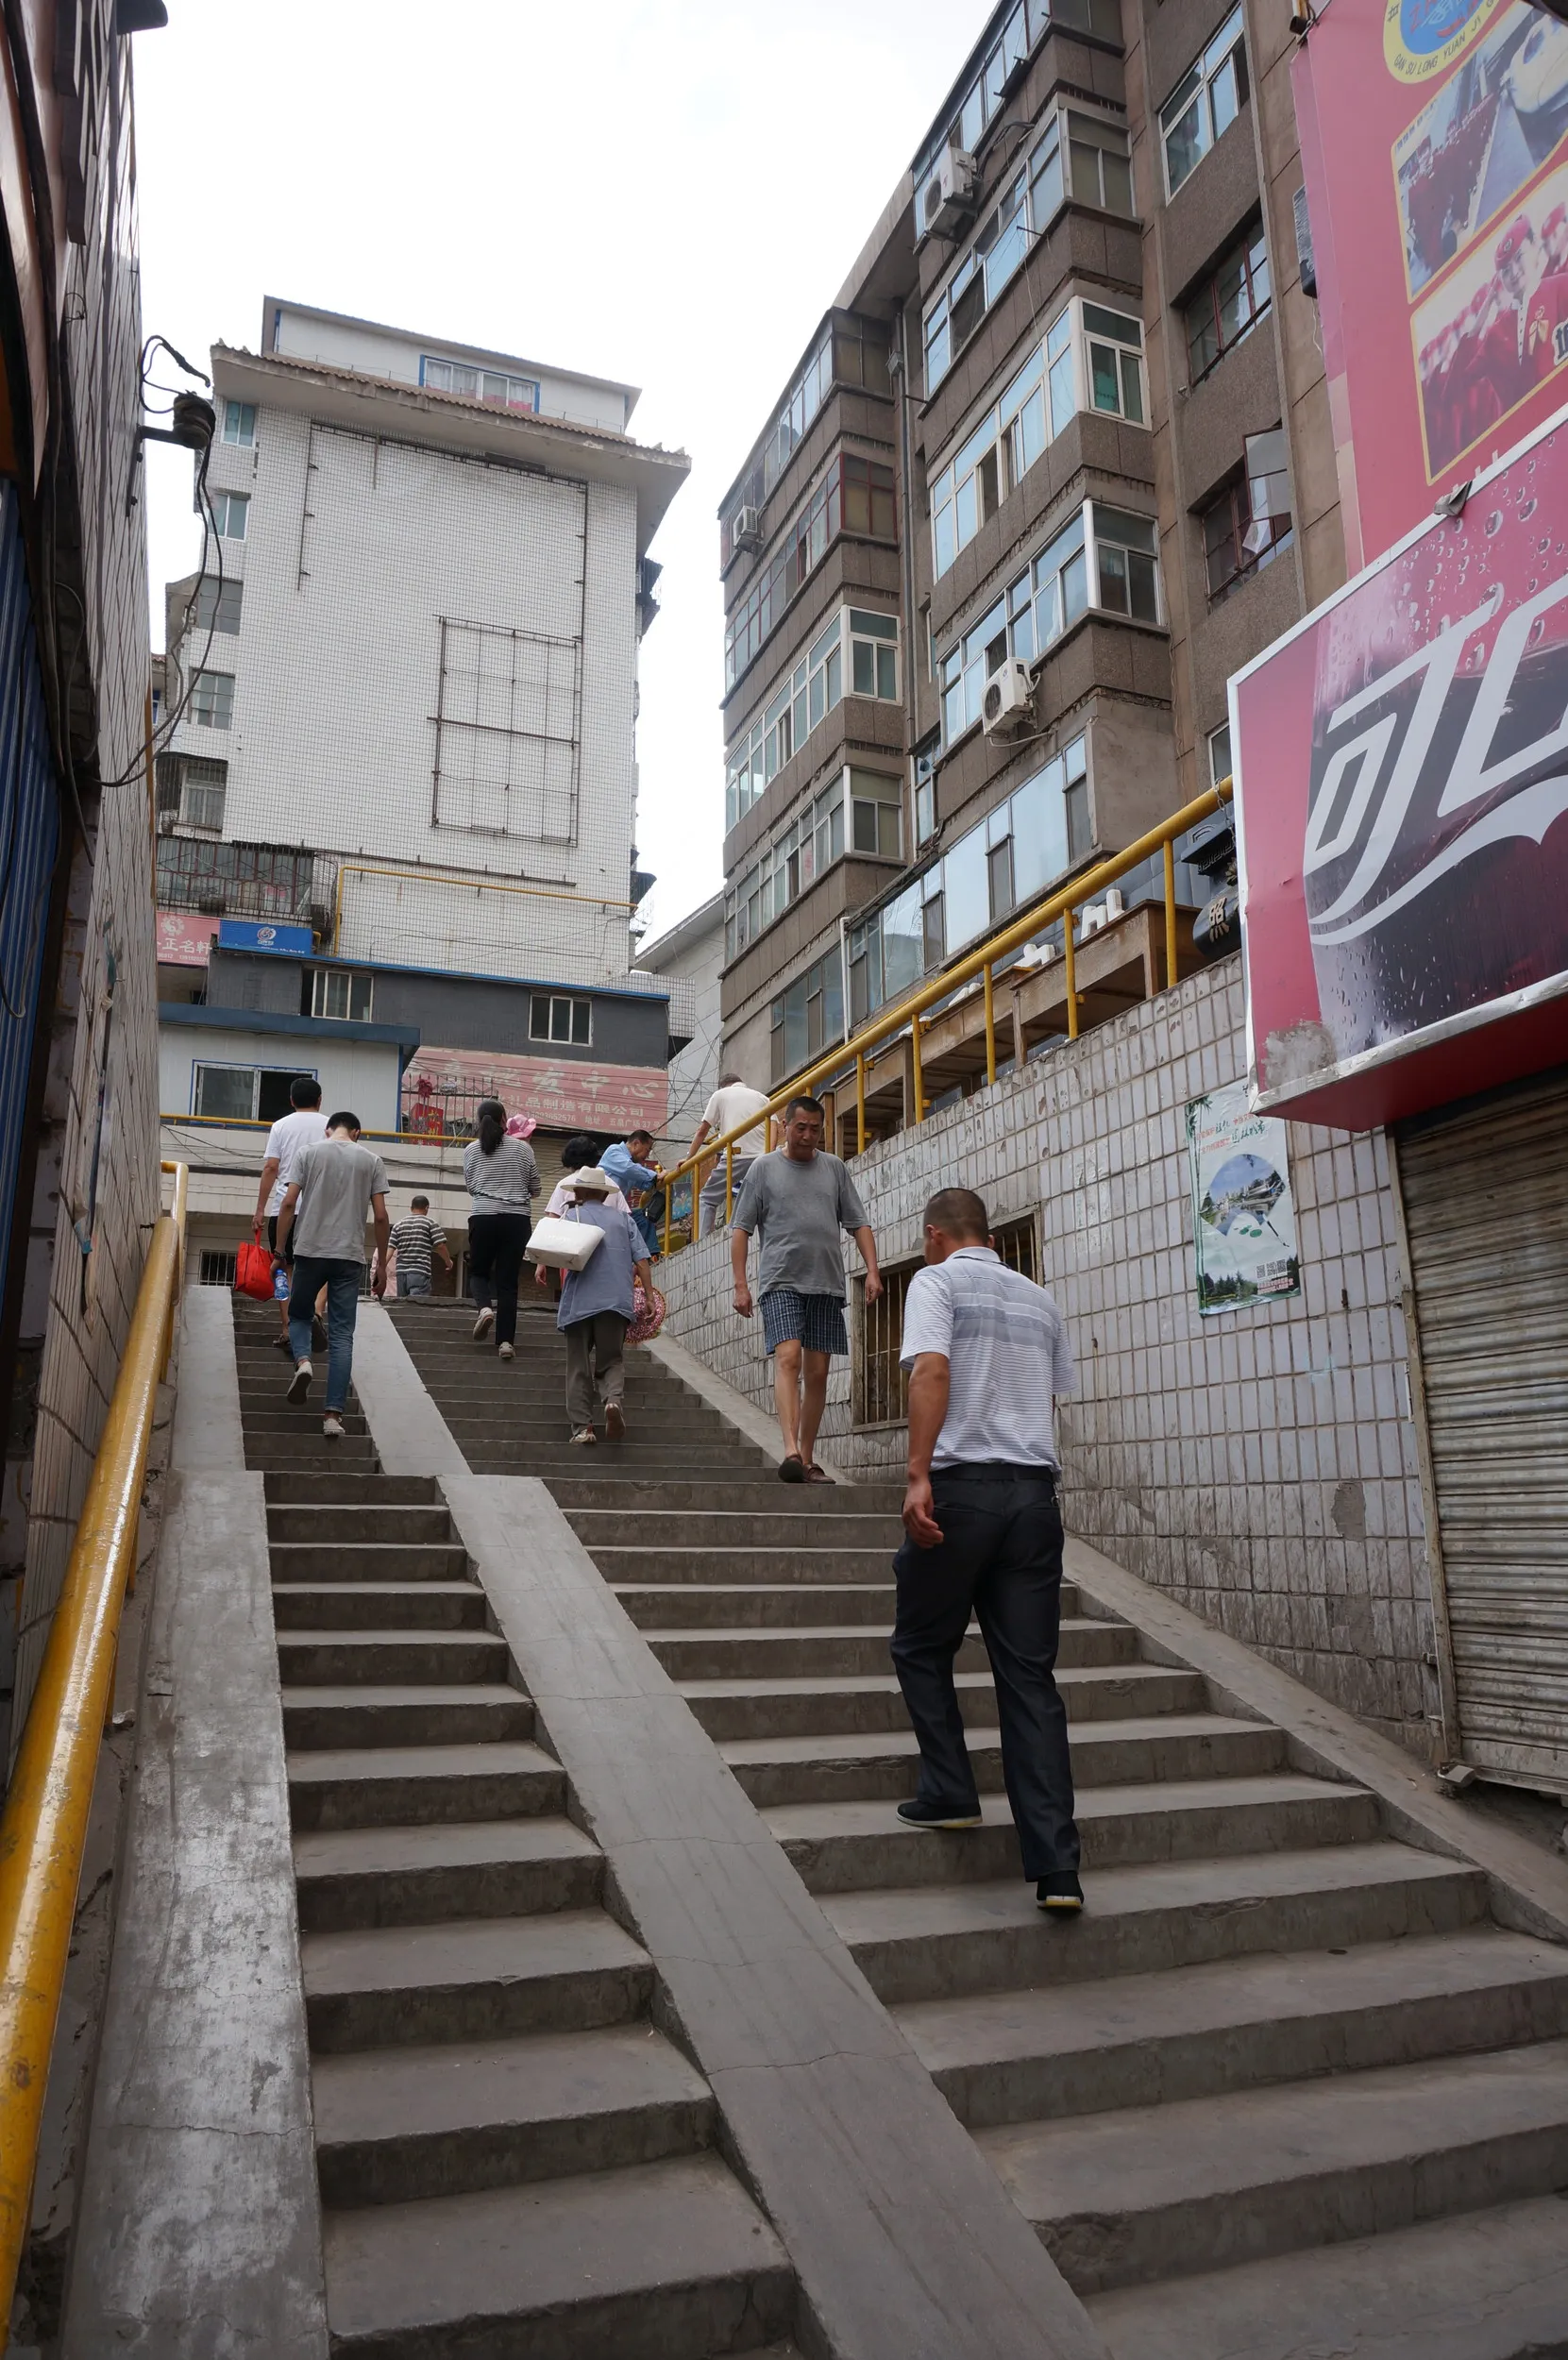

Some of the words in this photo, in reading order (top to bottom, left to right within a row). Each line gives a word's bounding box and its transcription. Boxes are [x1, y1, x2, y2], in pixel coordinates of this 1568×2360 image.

[1405, 62, 1417, 76] SU
[1416, 55, 1439, 76] LONG
[1443, 31, 1466, 60] YUAN
